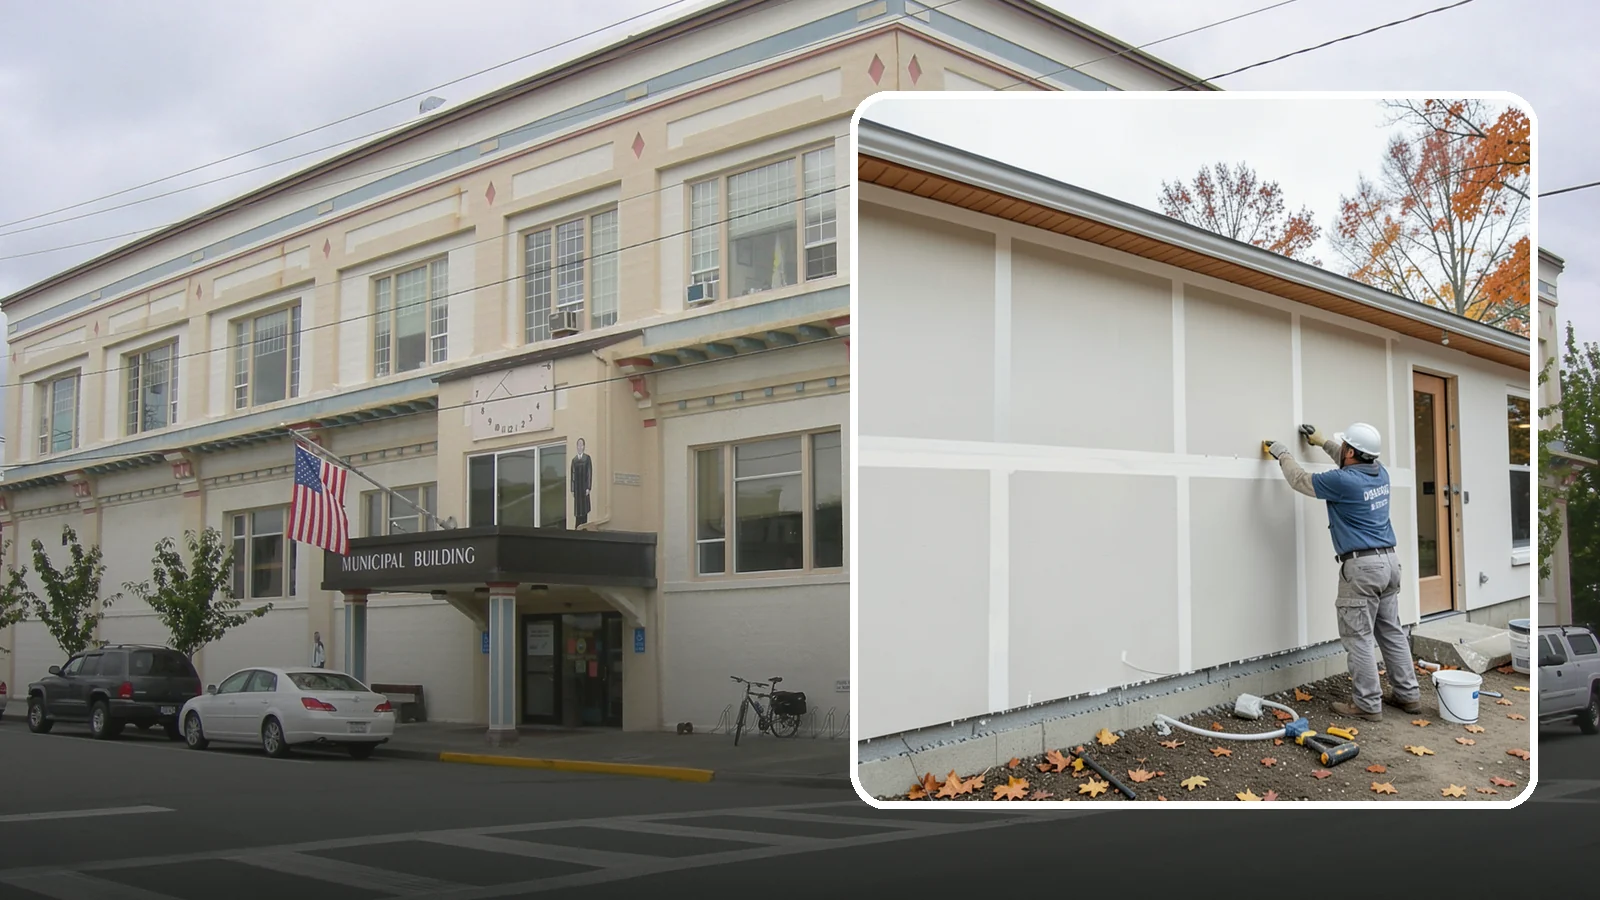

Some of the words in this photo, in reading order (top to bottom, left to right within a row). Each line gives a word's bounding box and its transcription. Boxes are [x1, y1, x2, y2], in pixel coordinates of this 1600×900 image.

[475, 390, 479, 398] 7
[536, 402, 541, 410] 4
[480, 407, 485, 415] 8
[487, 417, 492, 425] 9
[529, 414, 533, 422] 3
[494, 423, 500, 432] 10
[521, 420, 525, 428] 2
[507, 425, 513, 433] 12
[342, 552, 405, 572] MUNICIPAL
[414, 546, 475, 567] BUILDING
